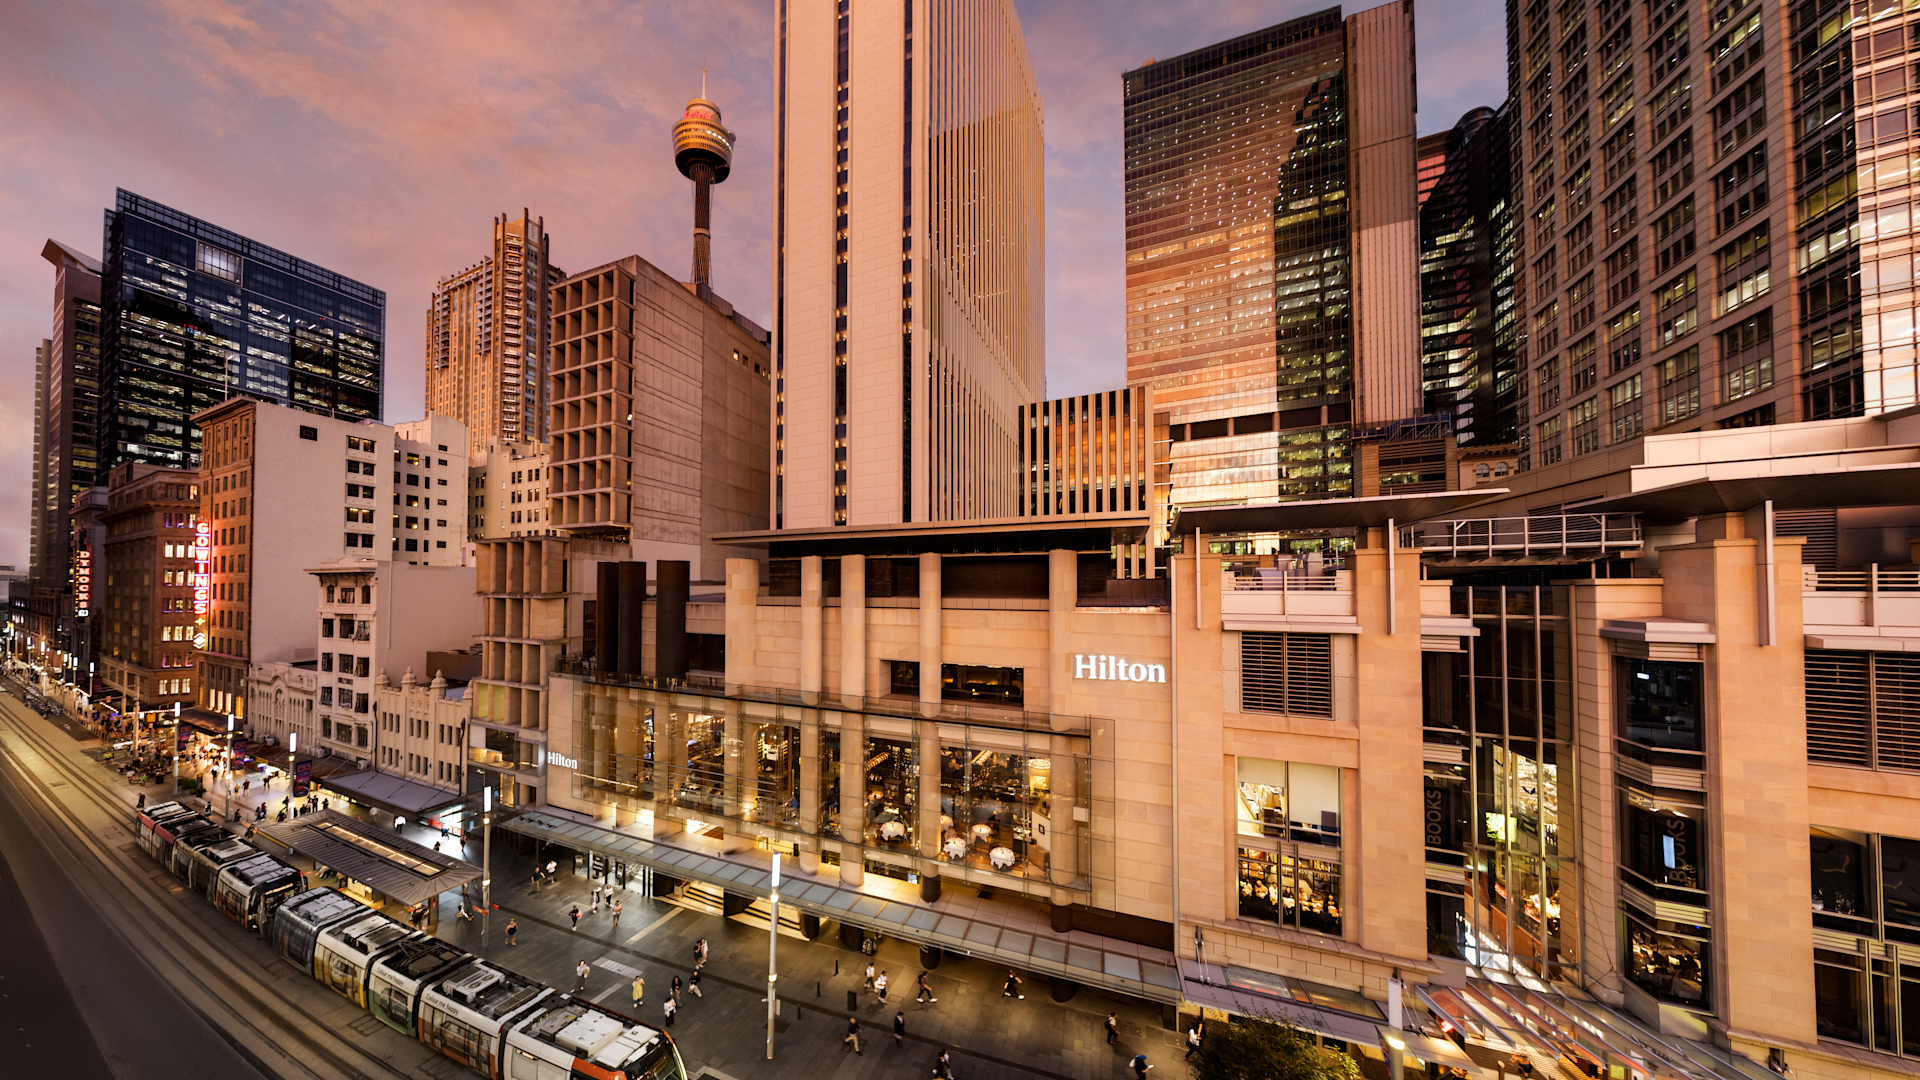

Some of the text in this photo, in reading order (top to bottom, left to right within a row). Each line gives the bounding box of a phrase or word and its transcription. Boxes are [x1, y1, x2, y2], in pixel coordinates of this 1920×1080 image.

[78, 550, 90, 608] DYMOCKS
[194, 522, 209, 615] GOWINGS
[1075, 654, 1167, 683] Hilton
[547, 751, 578, 770] Hilton
[1426, 789, 1442, 845] BOOKS
[425, 993, 439, 1004] Colour
[445, 1002, 460, 1016] happy
